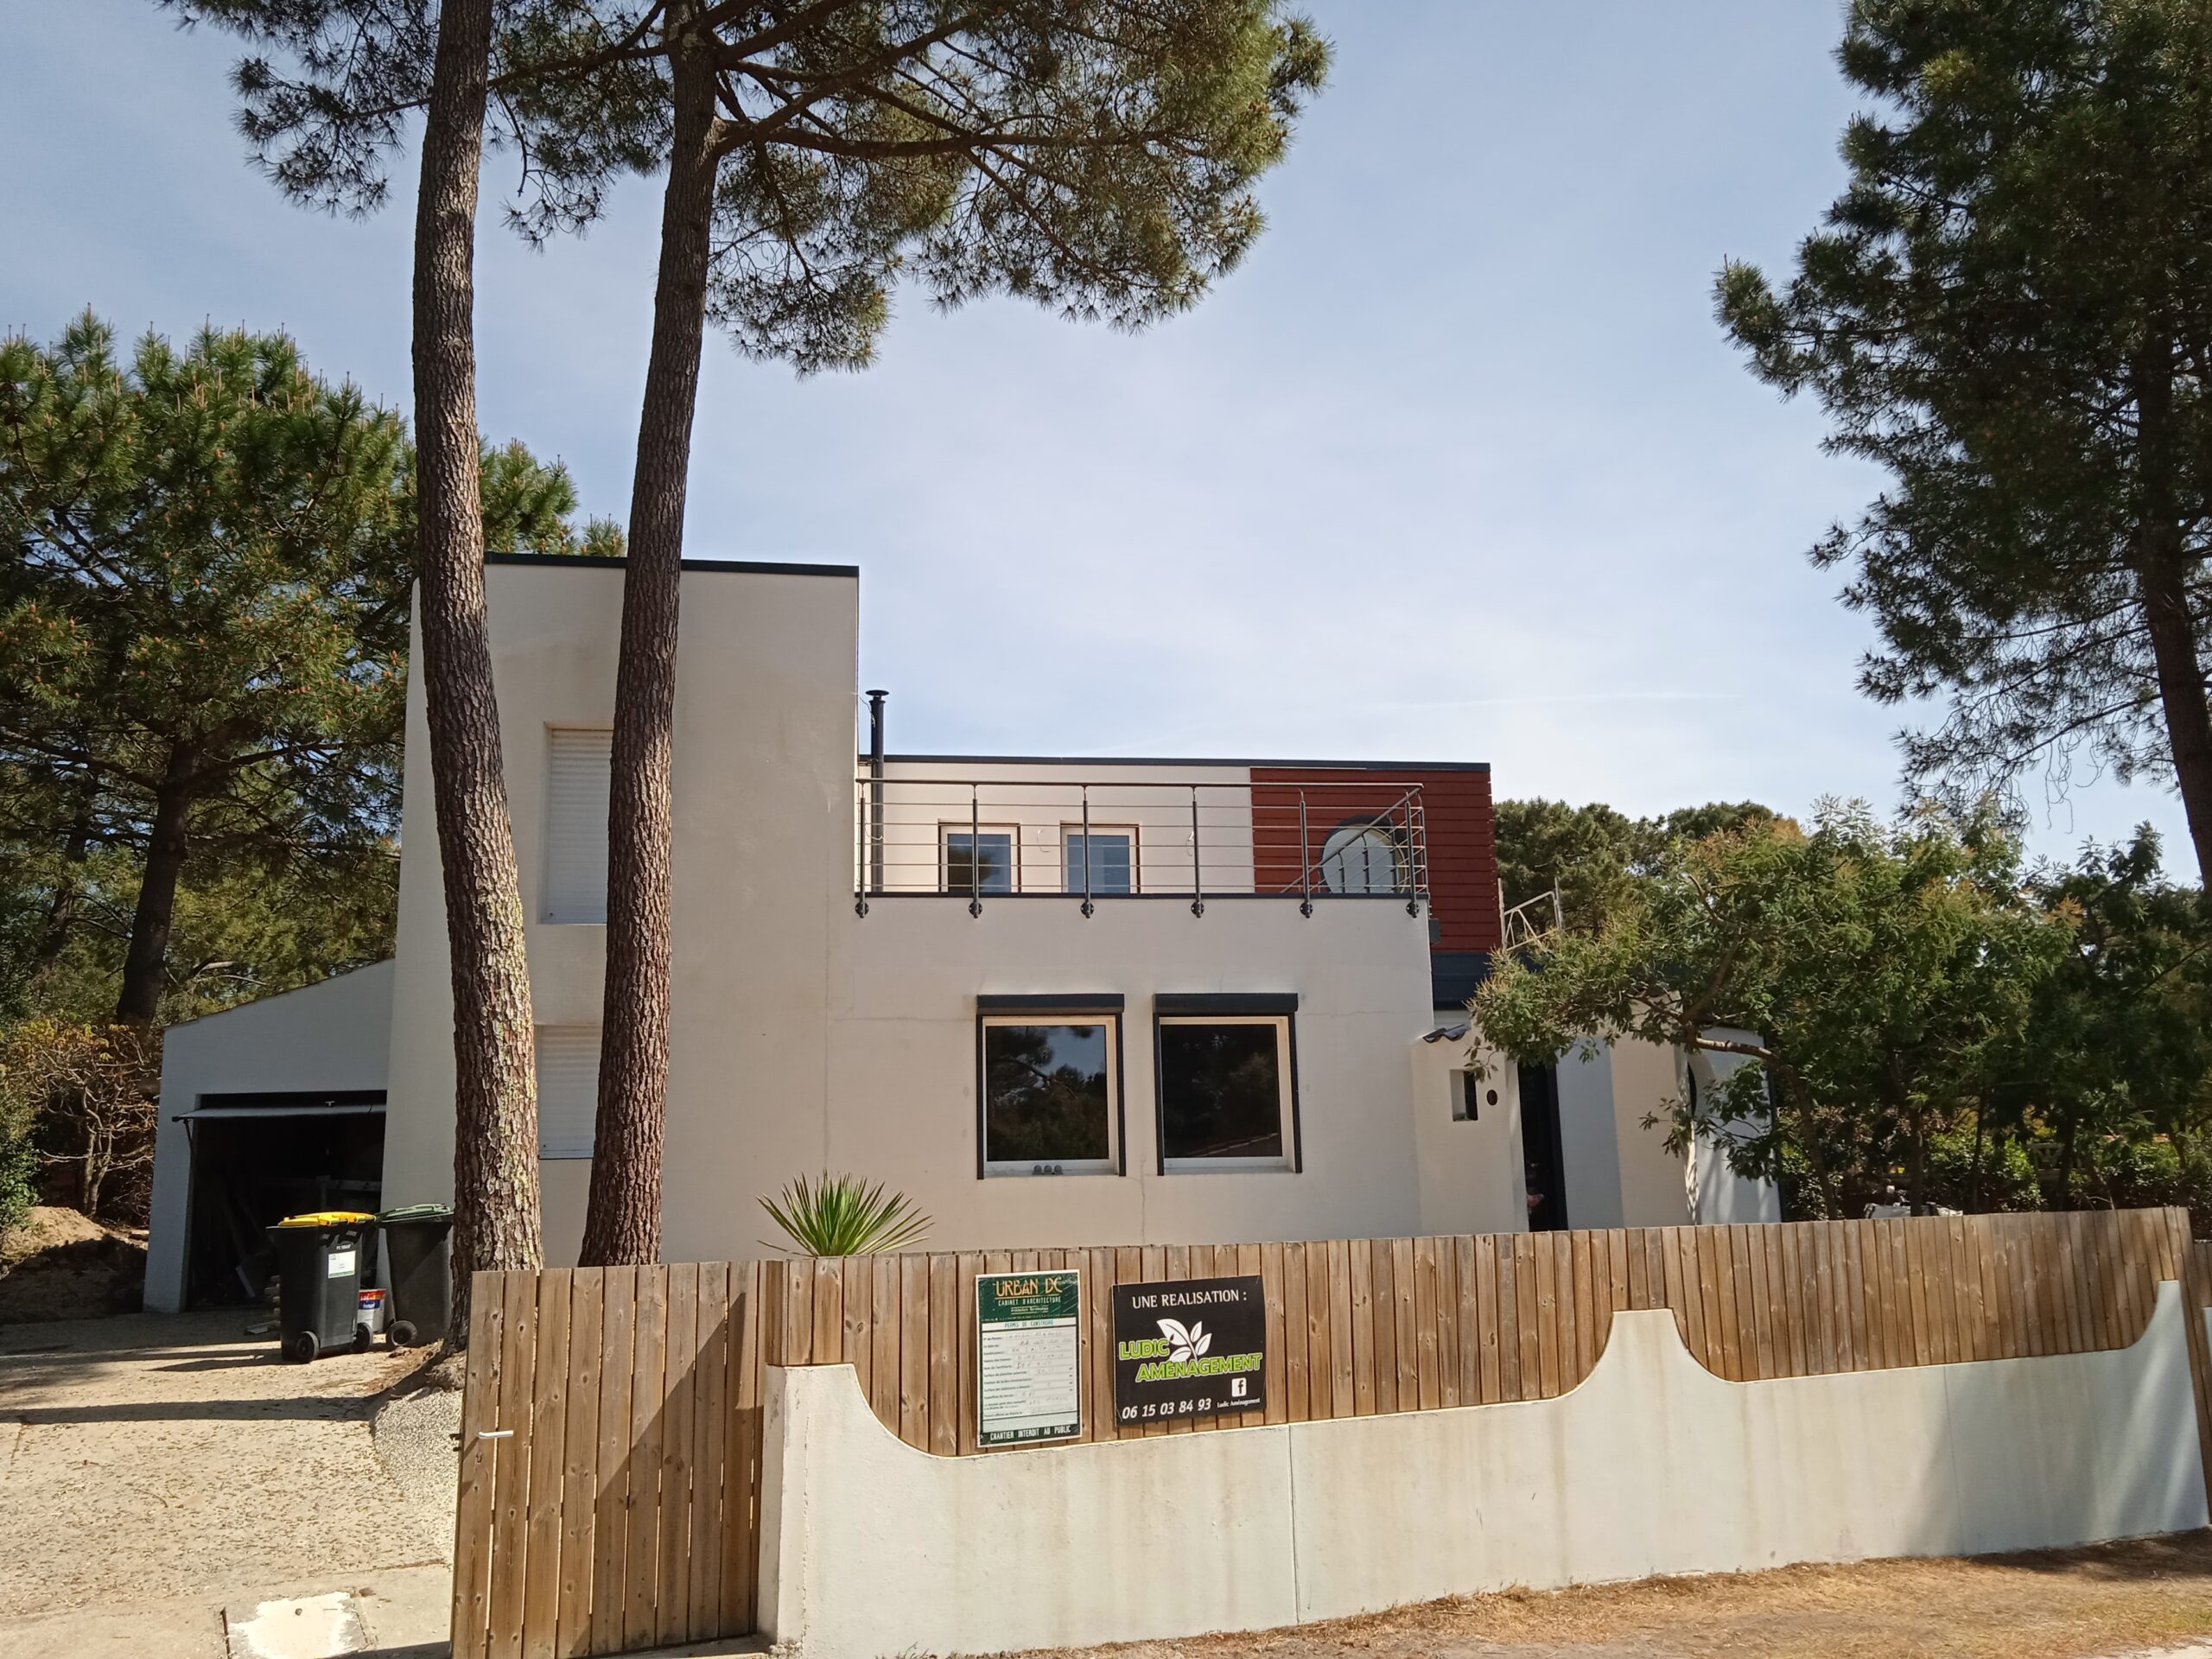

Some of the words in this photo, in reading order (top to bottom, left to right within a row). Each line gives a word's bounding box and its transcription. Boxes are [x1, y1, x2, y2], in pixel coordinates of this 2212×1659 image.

[995, 1279, 1039, 1297] URBAN
[1045, 1277, 1063, 1294] DC
[1022, 1296, 1062, 1306] D'ARCHITECTURE
[1132, 1294, 1158, 1309] UNE
[1161, 1289, 1239, 1306] REALISATION
[1119, 1338, 1170, 1360] LUDIC
[1135, 1352, 1263, 1382] AMÉNAGEMENT
[1122, 1406, 1138, 1420] 06
[1141, 1404, 1156, 1417] 15
[1160, 1402, 1174, 1415] 03
[1178, 1400, 1193, 1413] 84
[1198, 1397, 1211, 1411] 93
[989, 1430, 1014, 1441] CHANTIER
[1018, 1427, 1039, 1439] INTERDIT
[1043, 1427, 1051, 1435] AU
[1054, 1425, 1071, 1434] PUBLIC
